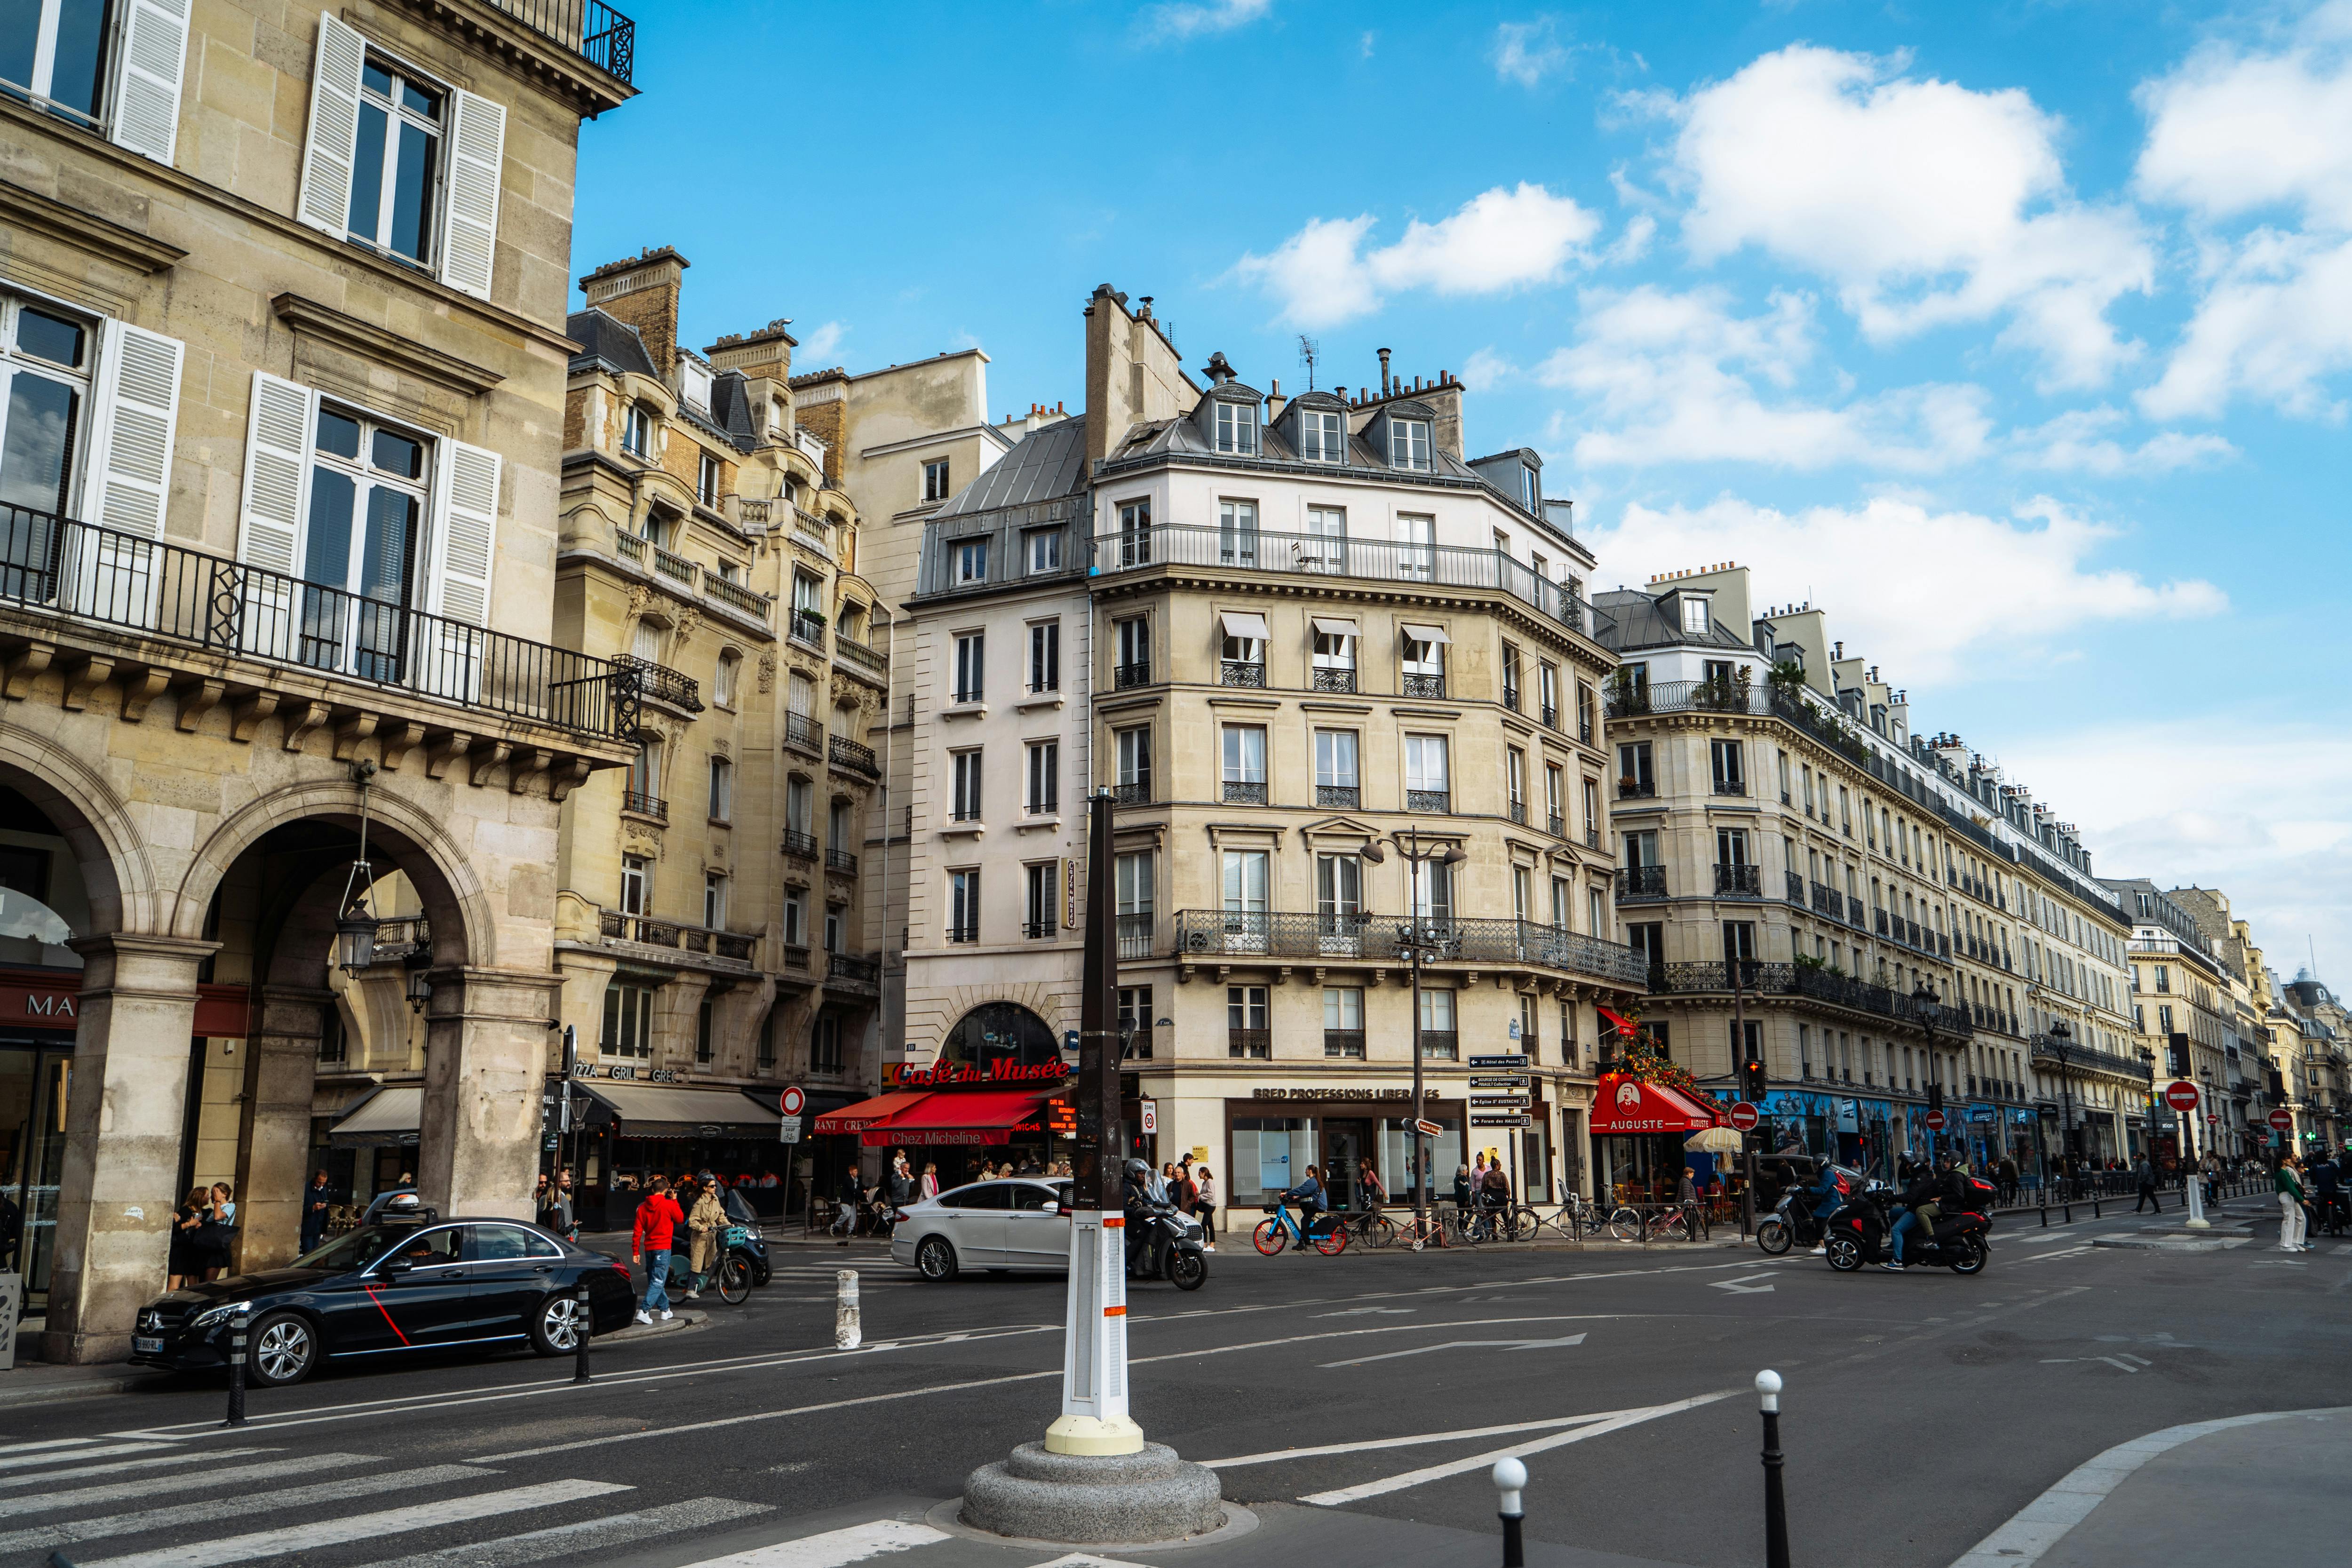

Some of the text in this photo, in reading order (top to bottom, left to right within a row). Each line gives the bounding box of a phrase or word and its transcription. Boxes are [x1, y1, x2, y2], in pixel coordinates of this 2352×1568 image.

[27, 995, 75, 1016] MA
[573, 1064, 678, 1083] IZZA GRILL GREC
[893, 1056, 1071, 1086] Café du Musée
[1254, 1088, 1440, 1099] BRED PROFESSIONS LIBERES
[543, 1095, 555, 1104] RILL
[1010, 1122, 1041, 1131] DWICHS
[1610, 1120, 1663, 1130] AUGUSTE
[1691, 1119, 1708, 1128] AUGUSTE
[891, 1131, 980, 1145] Chez Micheline
[1287, 1220, 1295, 1232] dott
[373, 1283, 387, 1292] G7
